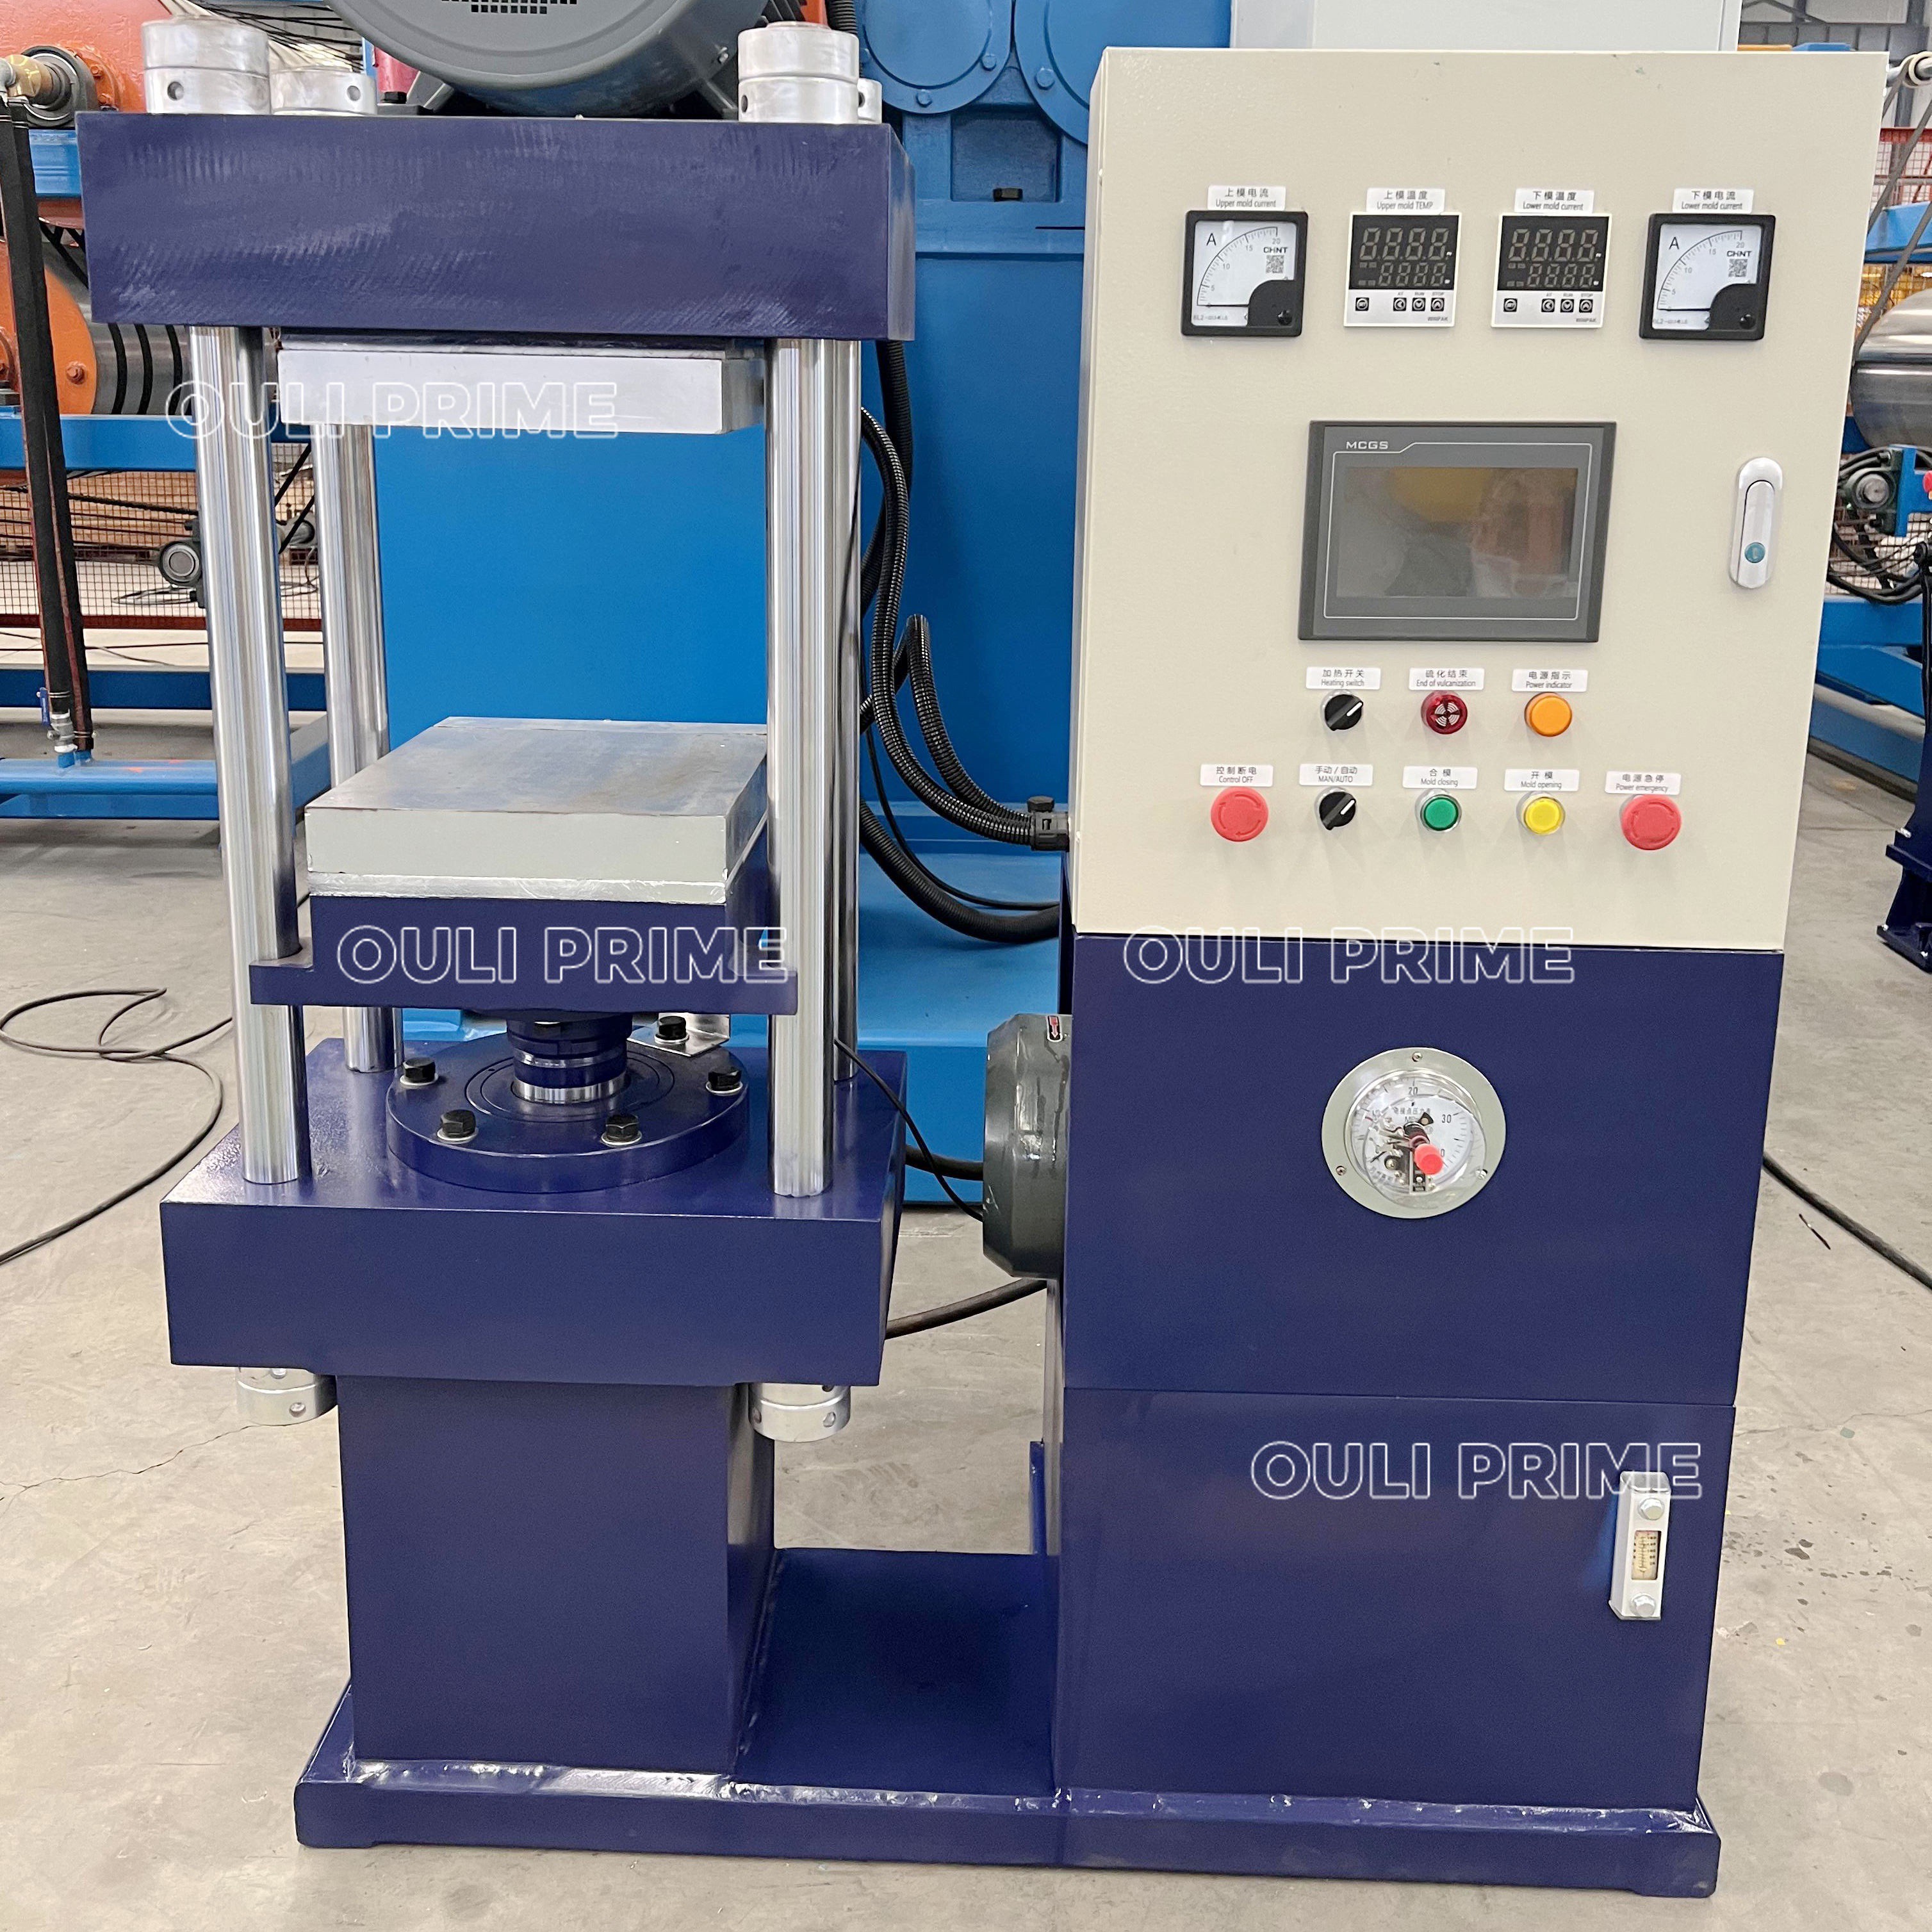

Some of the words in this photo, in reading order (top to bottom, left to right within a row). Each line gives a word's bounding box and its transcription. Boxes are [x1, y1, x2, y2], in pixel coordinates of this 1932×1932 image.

[1215, 199, 1235, 209] Upper
[1236, 199, 1253, 208] mold
[1254, 200, 1277, 208] current
[1377, 202, 1396, 211] Upper
[1397, 201, 1414, 209] mold
[1415, 201, 1434, 210] TEMP
[1523, 202, 1541, 210] Lower
[1543, 202, 1560, 211] mold
[1560, 202, 1584, 211] current
[1681, 201, 1701, 210] Lower
[1701, 202, 1719, 210] mold
[1719, 202, 1743, 211] current
[1206, 233, 1217, 246] A
[1668, 236, 1680, 250] A
[1345, 440, 1389, 450] MCGS
[1322, 669, 1364, 678] 加热开关
[1321, 679, 1345, 688] Heating
[1416, 679, 1427, 687] End
[1429, 679, 1436, 687] of
[1545, 681, 1573, 689] indicator
[1218, 775, 1241, 783] Control
[1437, 778, 1459, 787] closing
[1520, 780, 1536, 789] Mold
[1537, 781, 1562, 790] opening
[1616, 783, 1634, 791] Power
[1635, 785, 1669, 794] emergency
[1409, 1086, 1418, 1095] 20
[1441, 1113, 1452, 1124] 30
